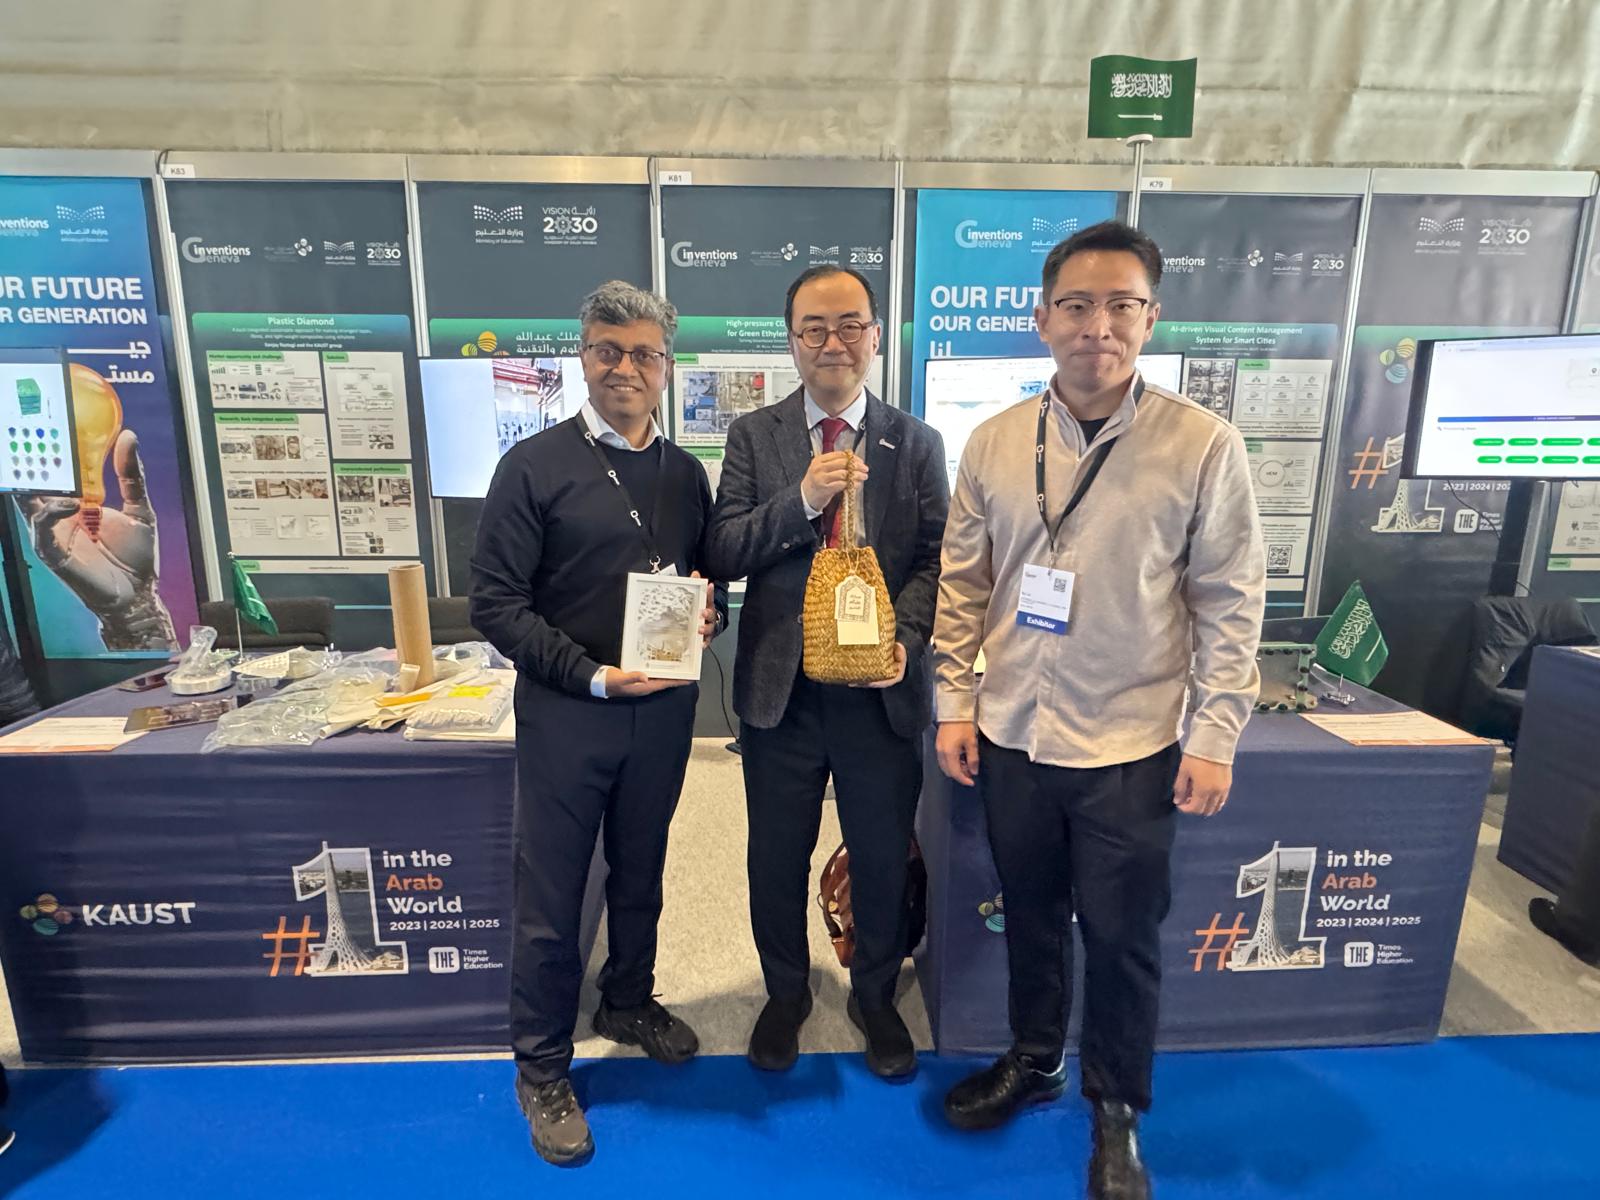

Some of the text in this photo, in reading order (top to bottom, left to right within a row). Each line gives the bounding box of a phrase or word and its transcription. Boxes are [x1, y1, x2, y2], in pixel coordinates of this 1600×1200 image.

[542, 206, 570, 214] VISION
[543, 215, 598, 234] 2030
[954, 220, 1012, 248] Geneva
[967, 228, 1023, 240] inventions
[1479, 228, 1530, 245] 2030
[193, 244, 251, 256] inventions
[682, 248, 738, 260] inventions
[0, 276, 144, 300] R FUTURE
[930, 285, 1043, 310] OUR FUT
[17, 307, 148, 325] GENERATION
[268, 316, 334, 326] Plastic Diamond
[930, 315, 972, 332] OUR
[726, 320, 774, 328] High-pressure
[1170, 326, 1303, 336] AI-driven Visual Content Management
[1196, 336, 1221, 345] System
[1222, 336, 1232, 344] for
[1233, 336, 1255, 344] Smart
[1458, 514, 1475, 528] THE
[1026, 616, 1056, 630] Exhibitor
[382, 850, 452, 868] in the
[1326, 850, 1392, 868] in the
[386, 873, 444, 892] Arab
[1322, 872, 1377, 890] Arab
[386, 896, 463, 914] World
[1320, 894, 1391, 912] World
[82, 902, 196, 926] KAUST
[390, 921, 422, 931] 2023
[430, 920, 460, 930] 2024
[469, 919, 500, 928] 2025
[1316, 918, 1346, 928] 2023
[1354, 918, 1384, 926] 2024
[1392, 916, 1421, 926] 2025
[462, 948, 487, 956] Times
[1349, 946, 1369, 963] THE
[1377, 950, 1402, 959] Higher
[434, 952, 455, 968] THE
[464, 956, 489, 964] Higher
[464, 962, 504, 970] Education
